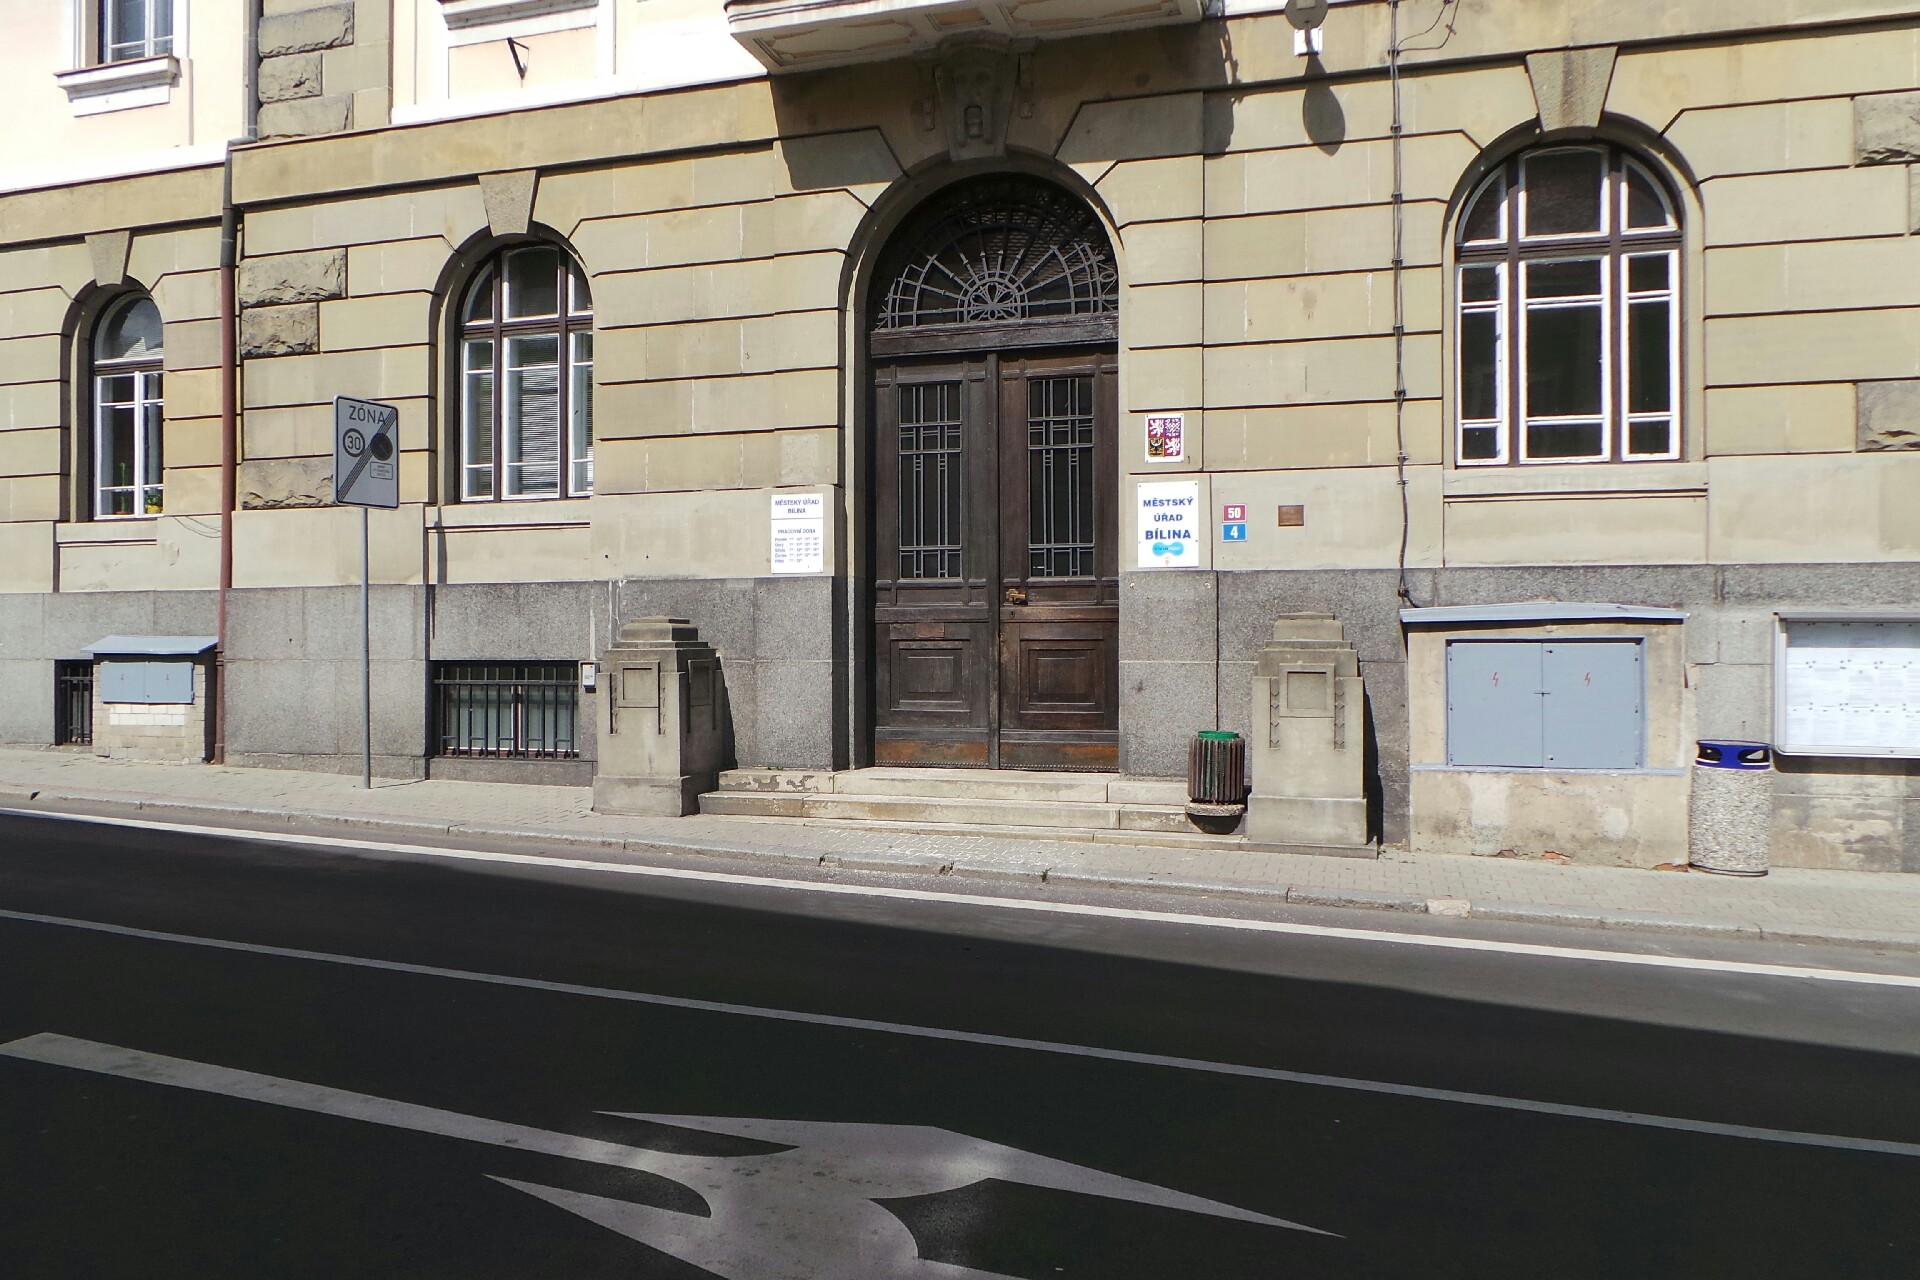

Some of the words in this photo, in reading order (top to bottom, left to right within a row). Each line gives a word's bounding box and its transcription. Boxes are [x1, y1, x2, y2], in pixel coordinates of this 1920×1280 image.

[349, 404, 386, 425] ZÓNA
[347, 435, 361, 451] 30
[1143, 496, 1194, 507] MĚSTSKÝ
[1153, 512, 1183, 522] ÚŘAD
[1228, 507, 1241, 519] 50
[1145, 527, 1191, 540] BÍLINA
[1230, 525, 1239, 539] 4
